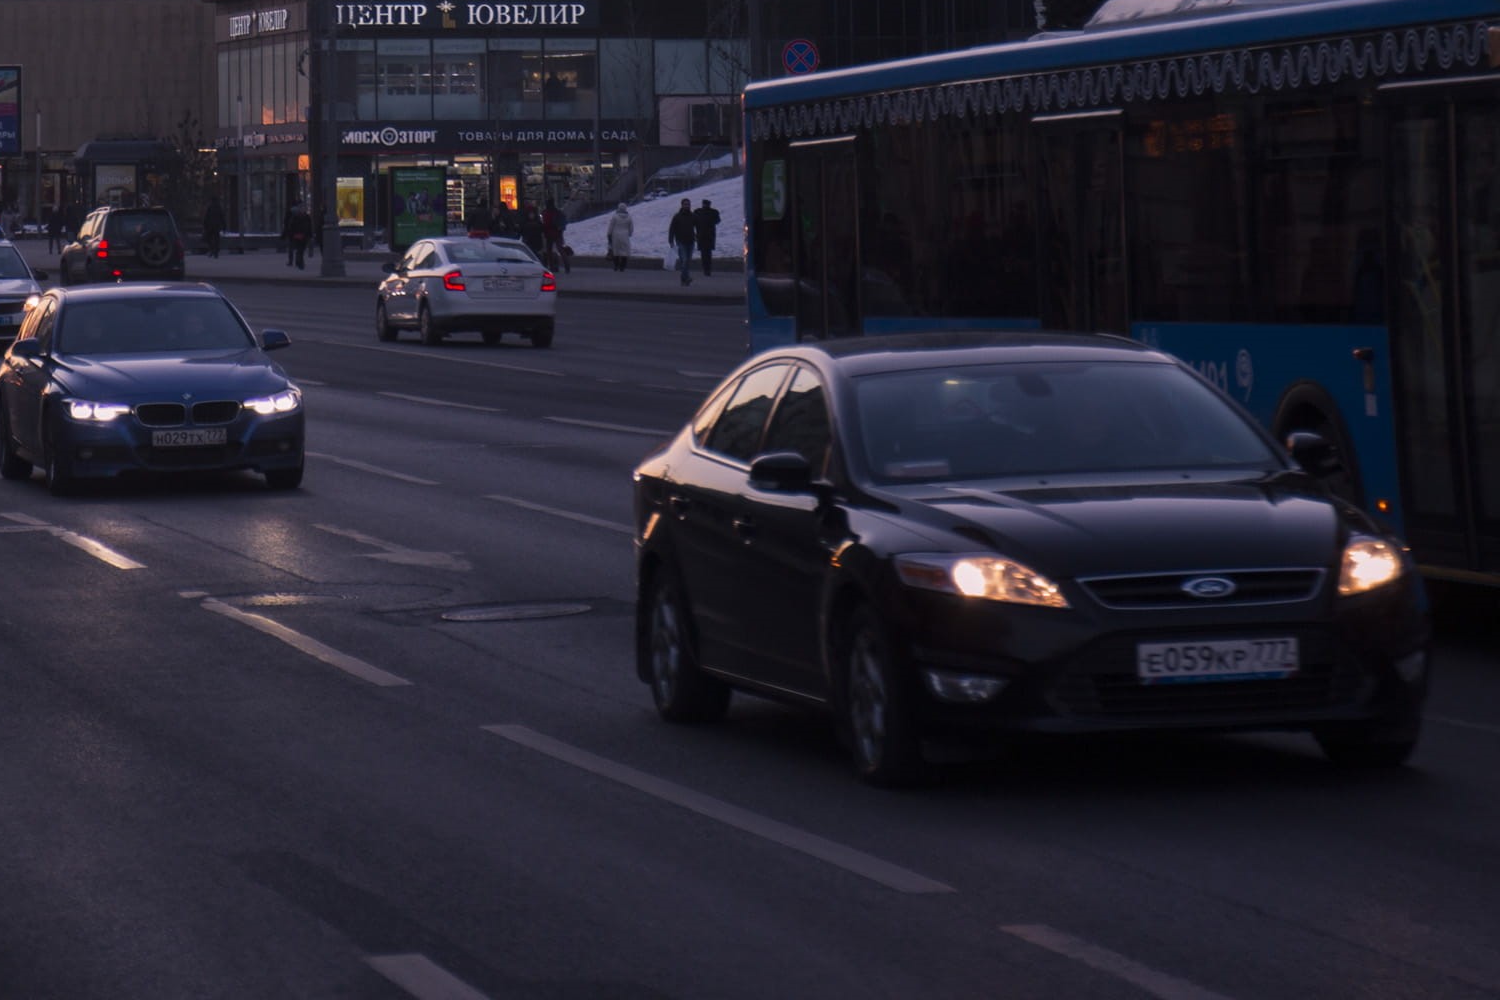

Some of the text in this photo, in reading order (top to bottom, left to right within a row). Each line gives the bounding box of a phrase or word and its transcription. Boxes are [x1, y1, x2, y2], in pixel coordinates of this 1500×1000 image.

[257, 9, 288, 32] ЮВЕЛИР
[335, 3, 587, 30] ЦЕНТР ЮВЕЛИР
[517, 131, 544, 142] ДЛЯ
[547, 130, 586, 142] ДОМА
[601, 130, 638, 142] САДА
[1252, 640, 1290, 662] 777
